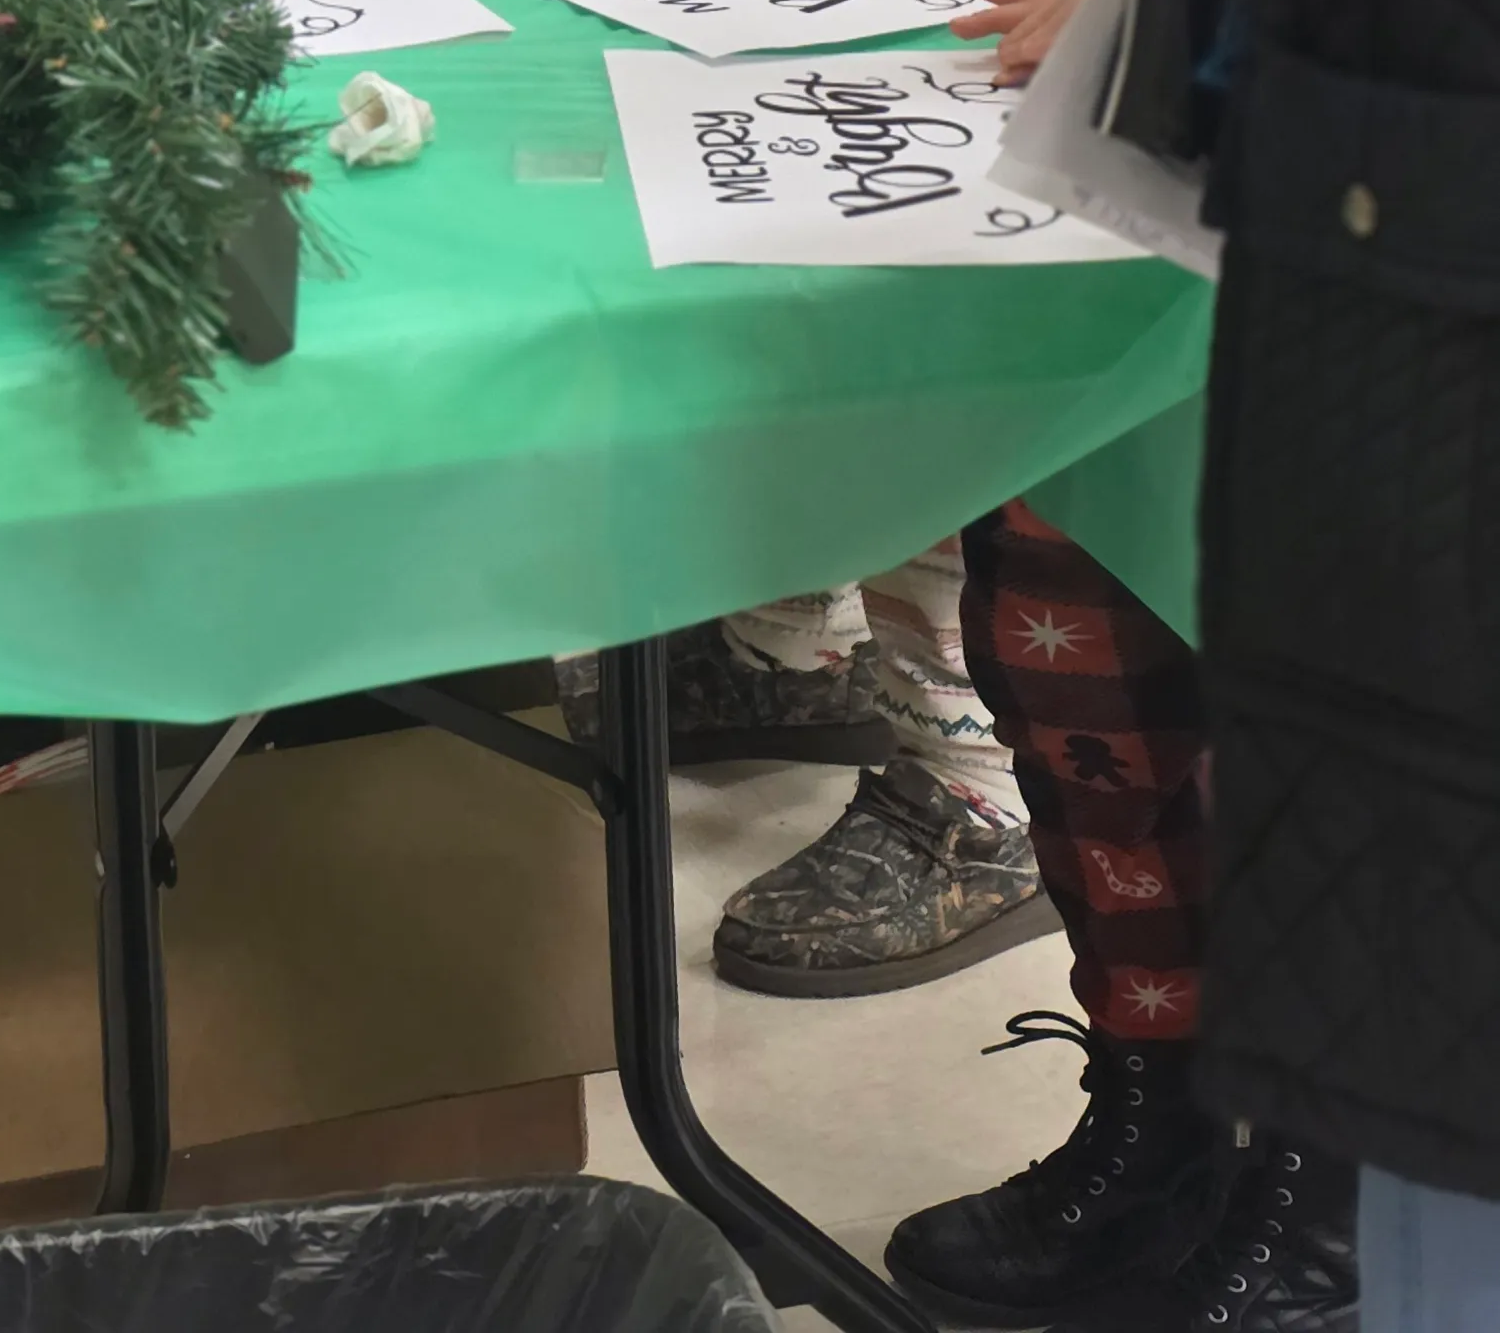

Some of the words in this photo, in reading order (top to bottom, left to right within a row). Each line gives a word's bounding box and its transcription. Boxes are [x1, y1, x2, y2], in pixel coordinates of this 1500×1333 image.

[691, 110, 775, 204] MERRY
[753, 72, 974, 218] Bright
[766, 136, 821, 157] &
